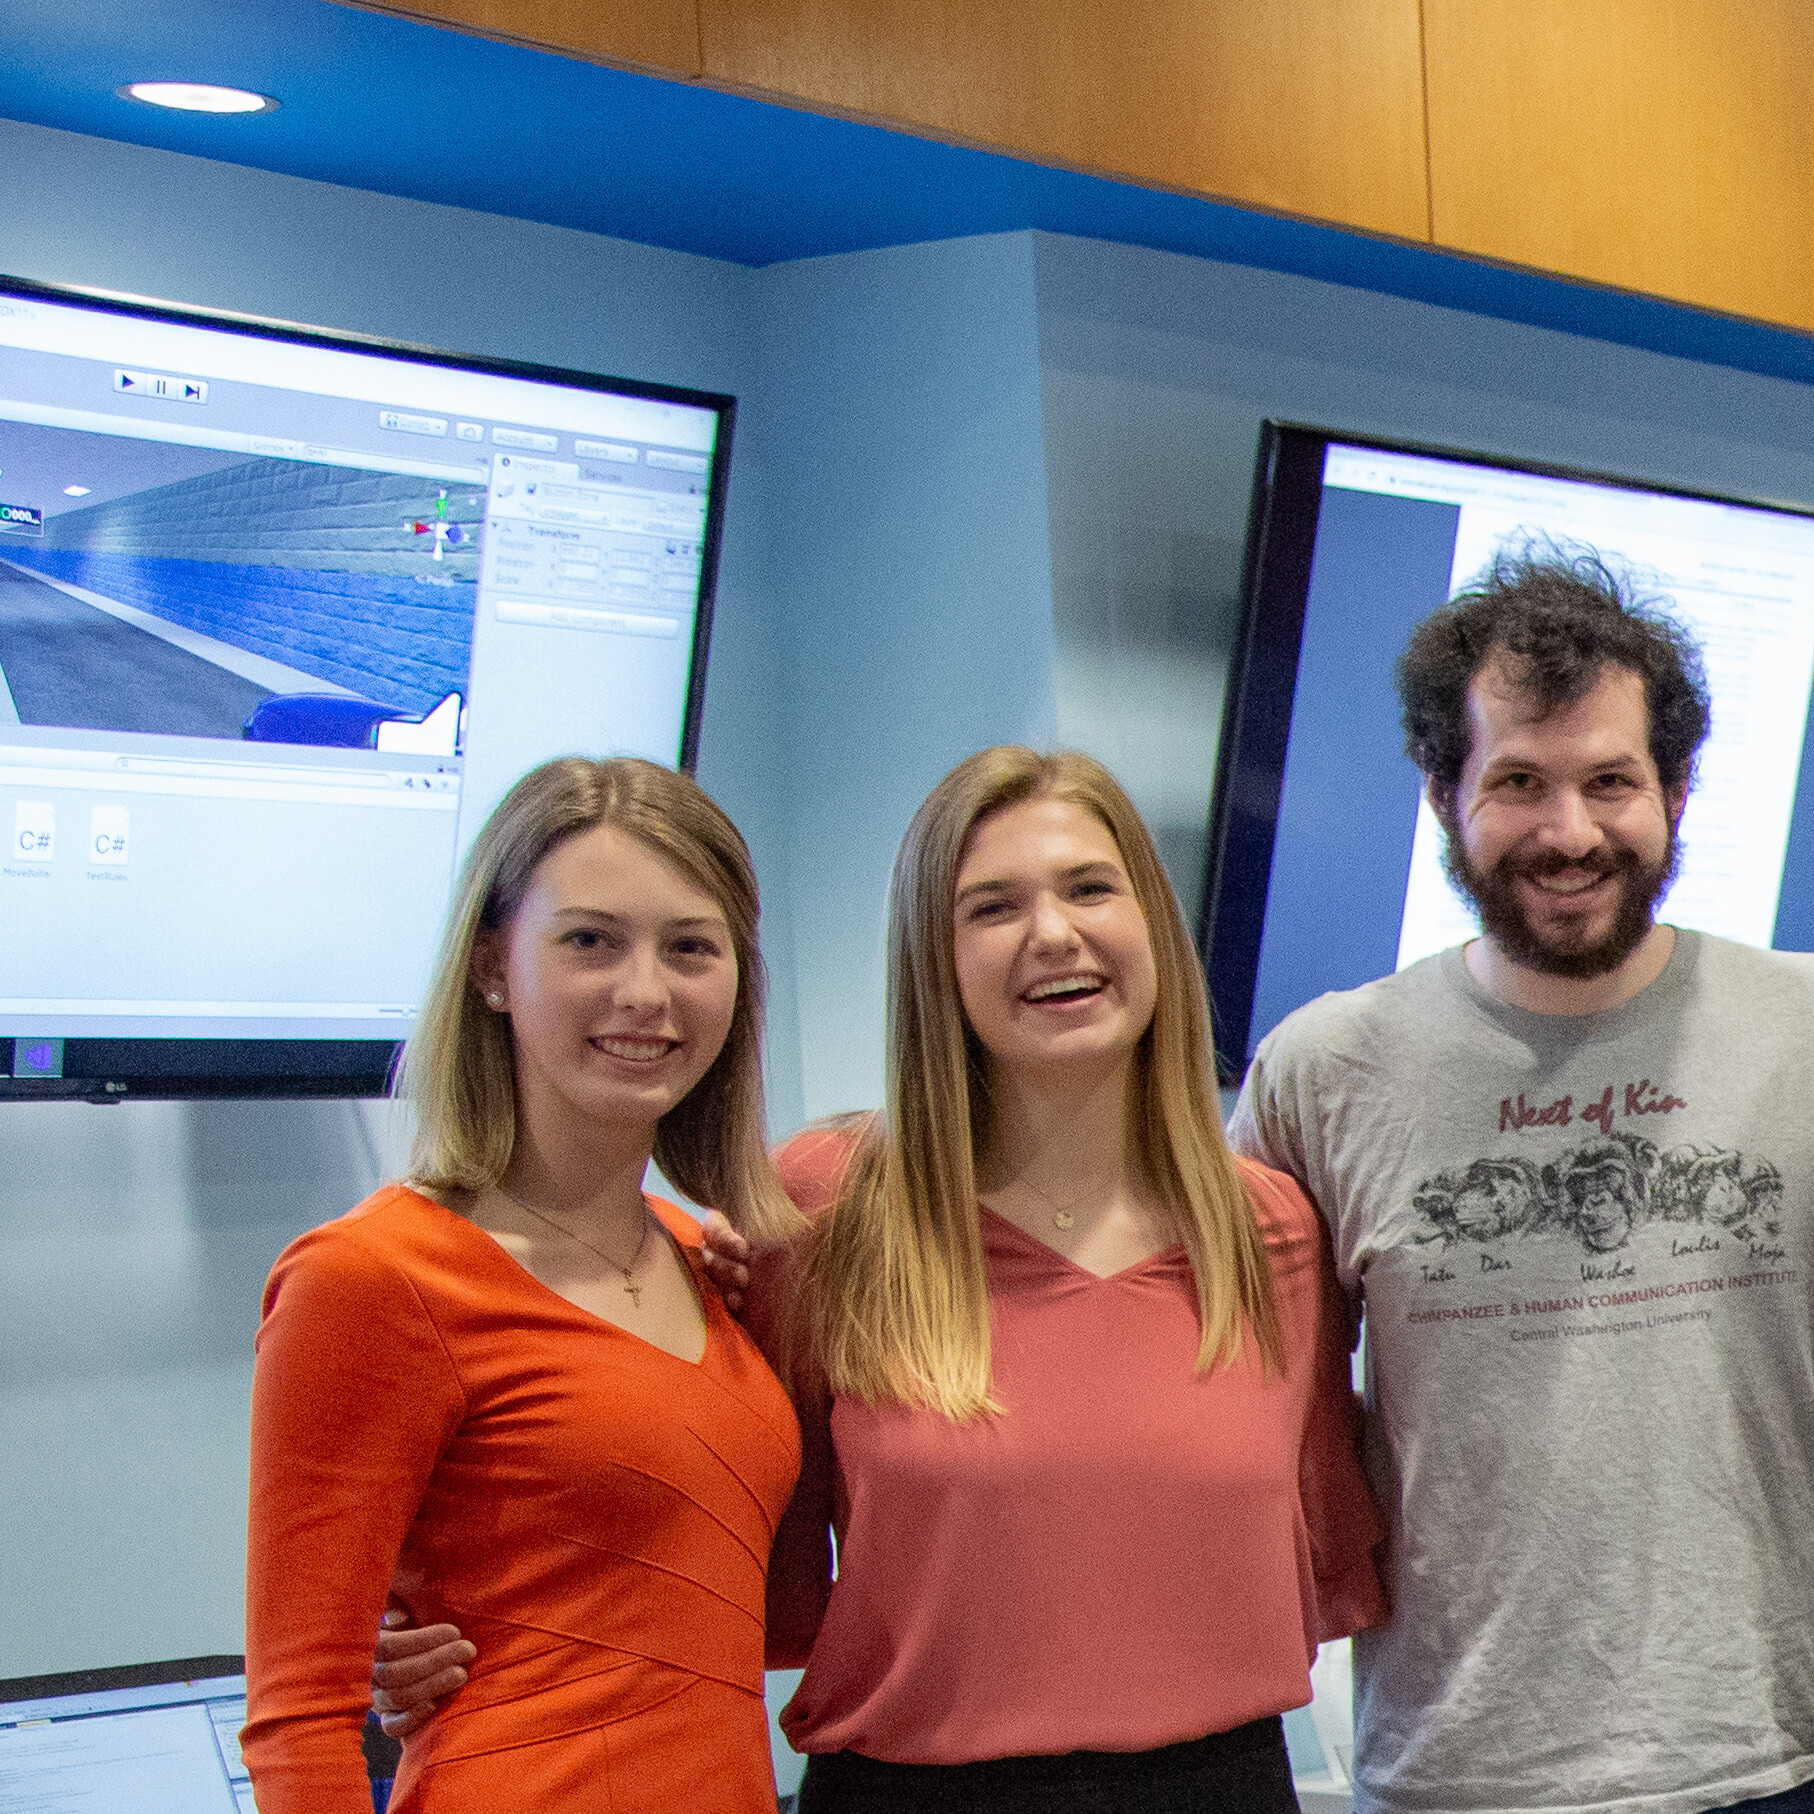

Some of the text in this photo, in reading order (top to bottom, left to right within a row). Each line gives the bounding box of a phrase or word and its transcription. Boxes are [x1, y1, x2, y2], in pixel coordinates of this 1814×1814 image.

[20, 830, 51, 851] C#
[95, 833, 126, 854] C#
[1498, 1079, 1688, 1134] Next of Kin
[1407, 1269, 1798, 1325] CHIMPANZEE & HUMAN COMMUNICATION INSTITUTE
[1509, 1308, 1712, 1342] Central Washington University
